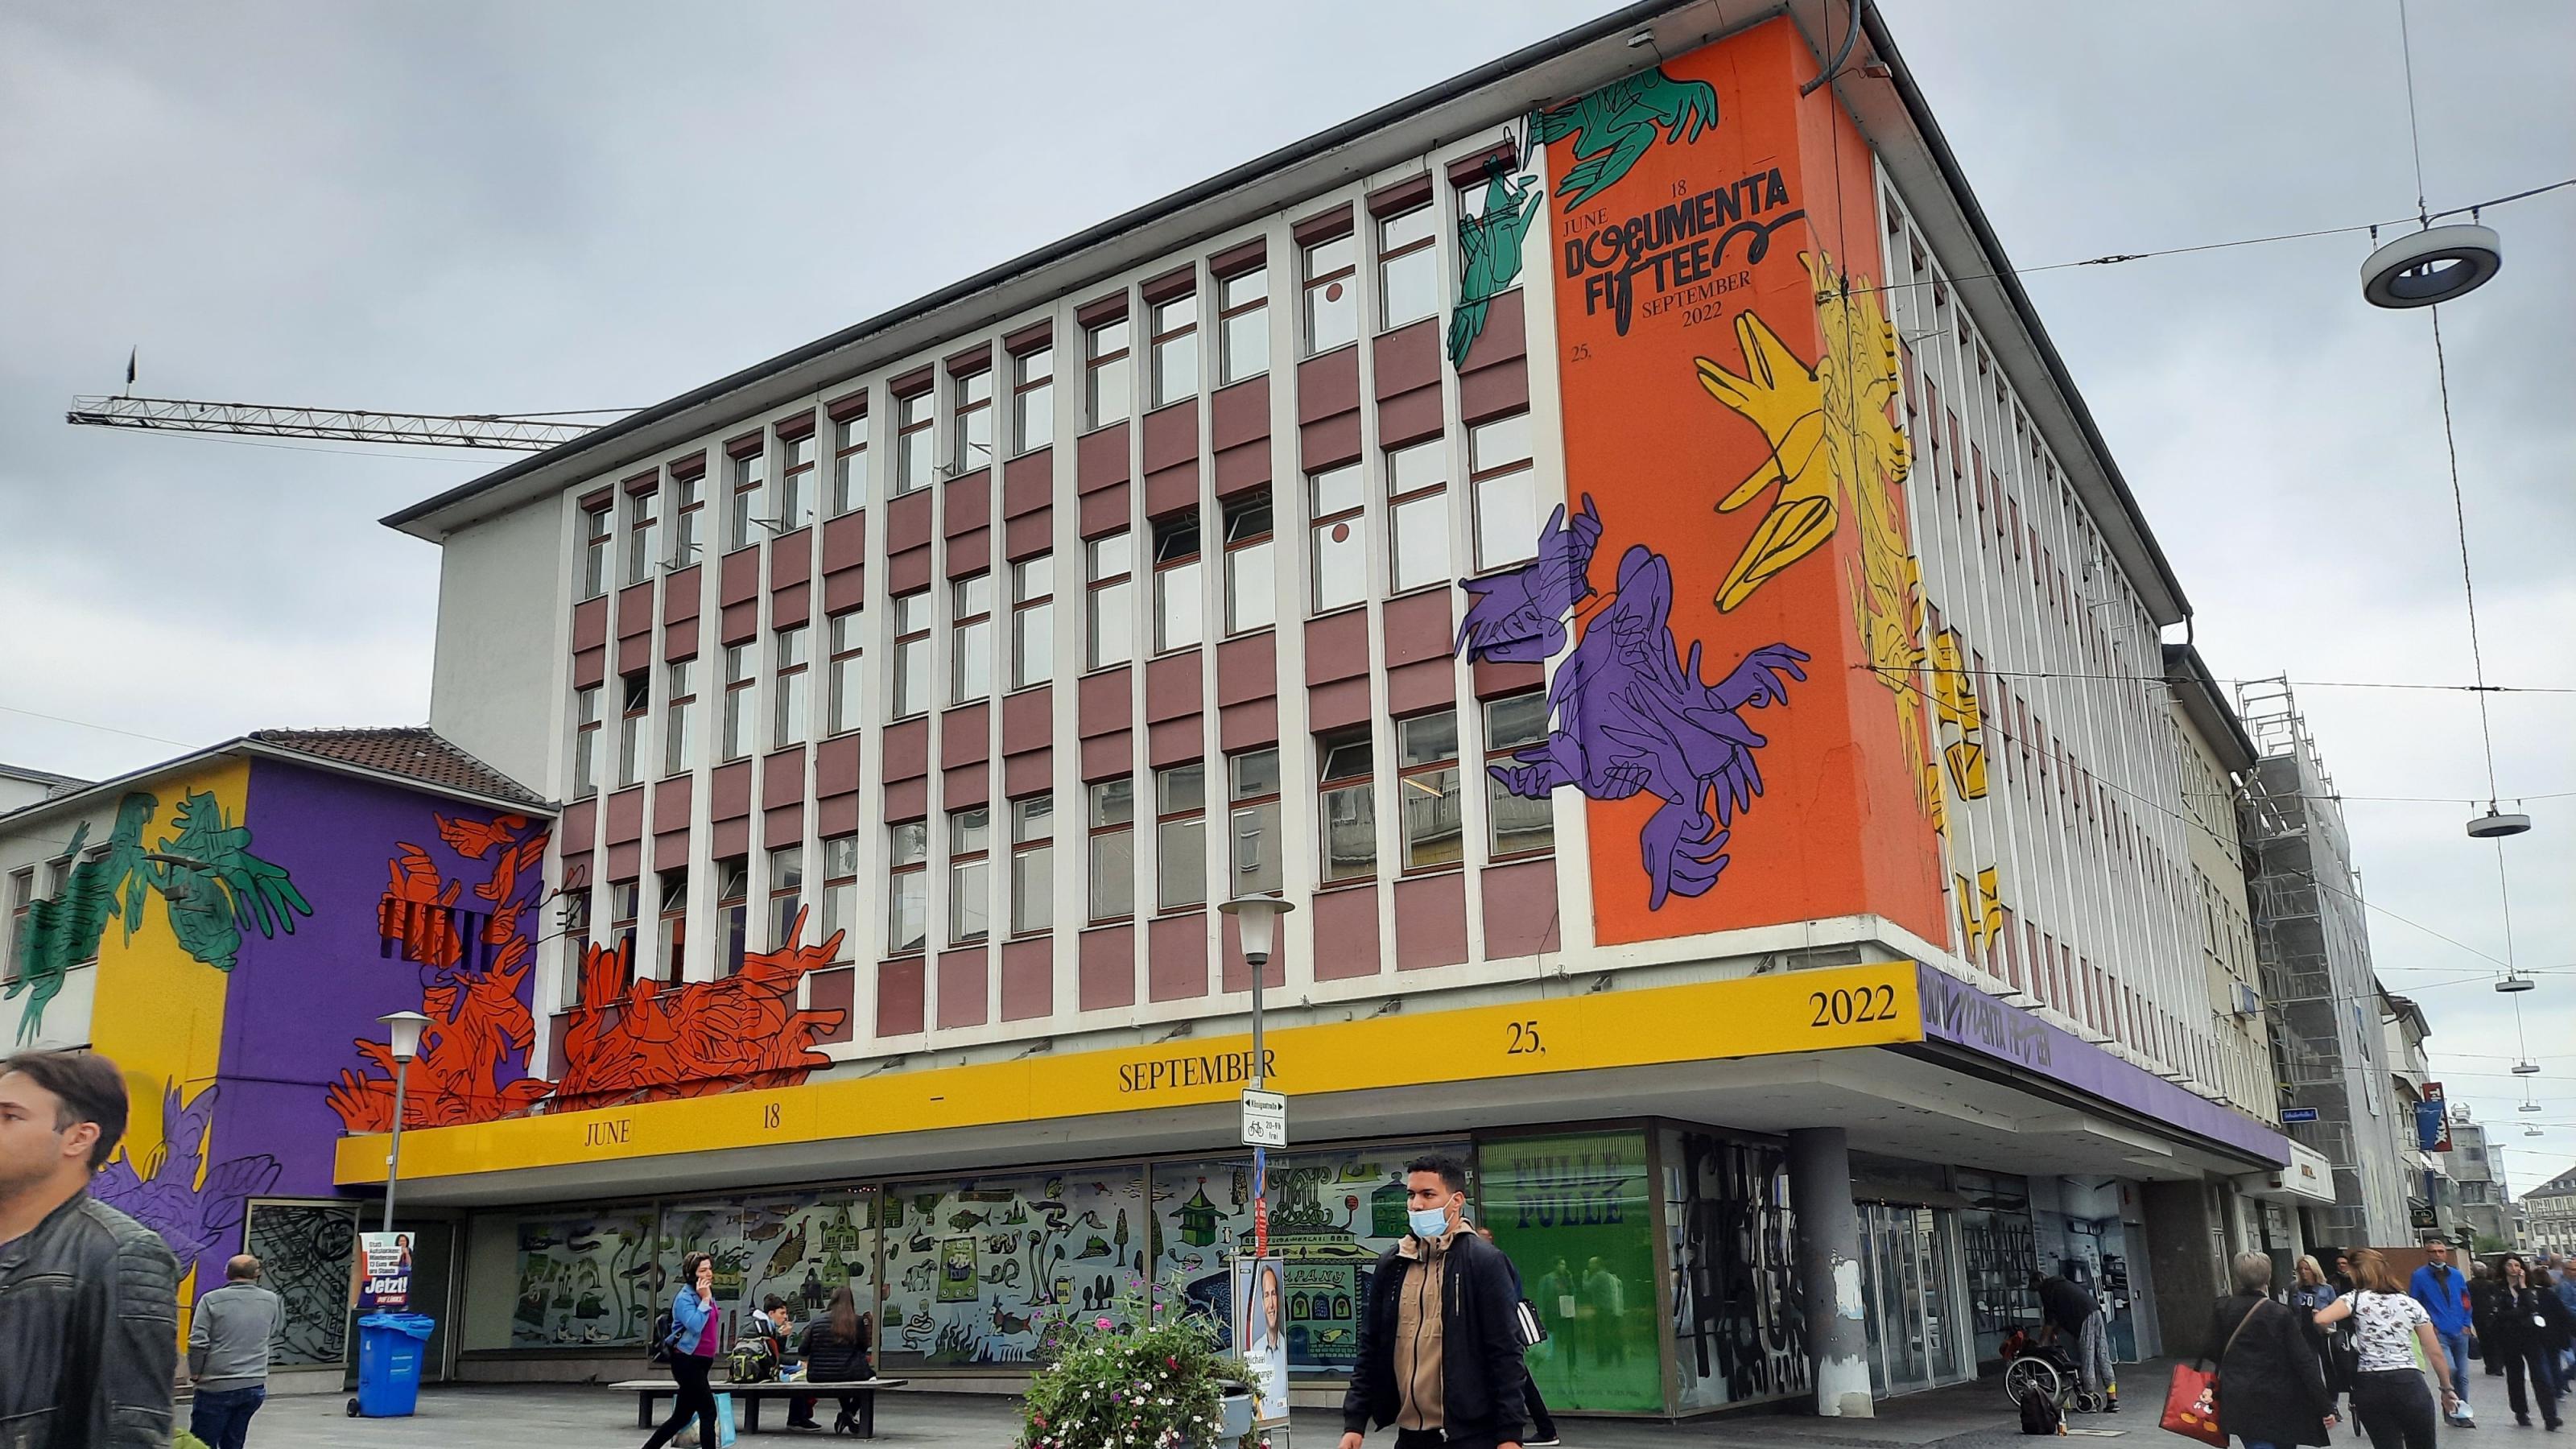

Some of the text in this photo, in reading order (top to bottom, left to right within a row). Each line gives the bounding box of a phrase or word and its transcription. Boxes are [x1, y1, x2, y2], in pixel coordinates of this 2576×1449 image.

[1563, 207, 1609, 237] JUNE
[1670, 179, 1687, 200] 18
[1566, 167, 1790, 279] DOCUMENTA
[1641, 270, 1752, 319] SEPTEMBER
[1571, 300, 1723, 364] 25, 2022
[584, 1118, 631, 1147] JUNE
[763, 1102, 781, 1129] 18
[1117, 1048, 1278, 1094] SEPTEMBER
[1506, 1021, 1547, 1057] 25,
[1809, 984, 1897, 1027] 2022
[1269, 1131, 1279, 1140] frei
[365, 1276, 408, 1294] Jetzt!
